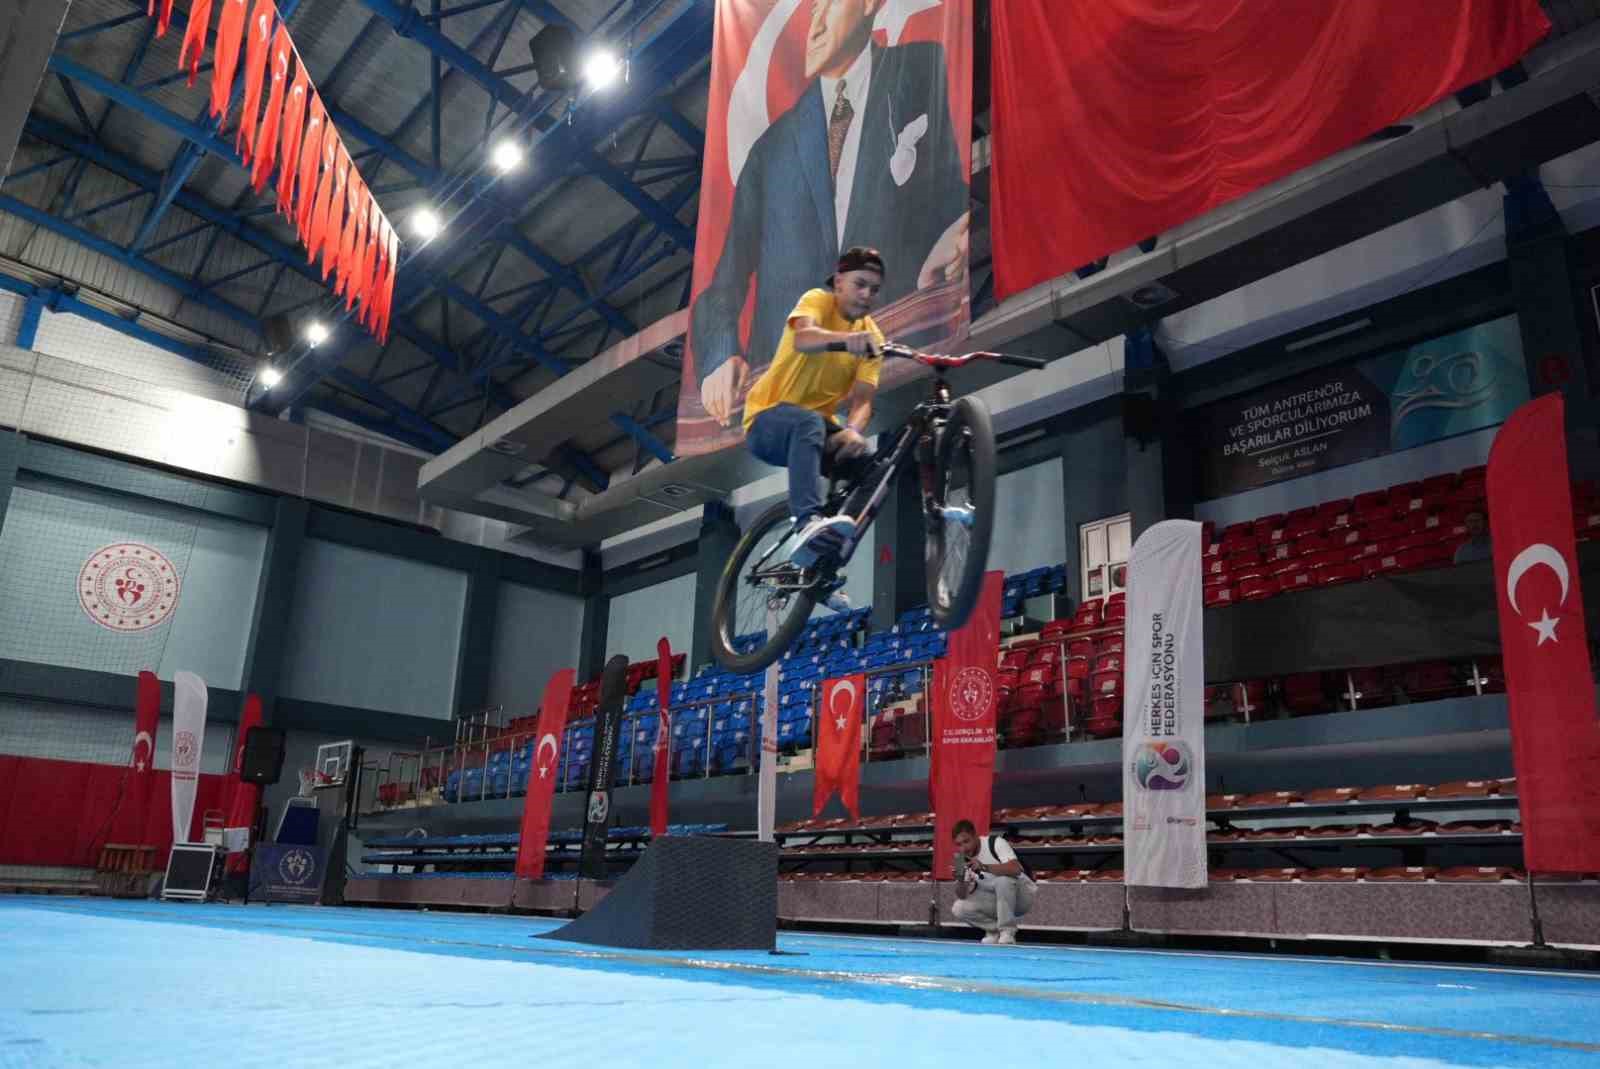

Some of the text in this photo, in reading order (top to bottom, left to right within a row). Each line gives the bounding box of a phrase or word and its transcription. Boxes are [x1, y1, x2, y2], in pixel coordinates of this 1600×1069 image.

[1229, 391, 1361, 438] VE SPORCULARIMIZA
[1151, 612, 1162, 649] SPOR
[1163, 633, 1175, 736] FEDERASYONU
[1151, 684, 1162, 737] HERKES
